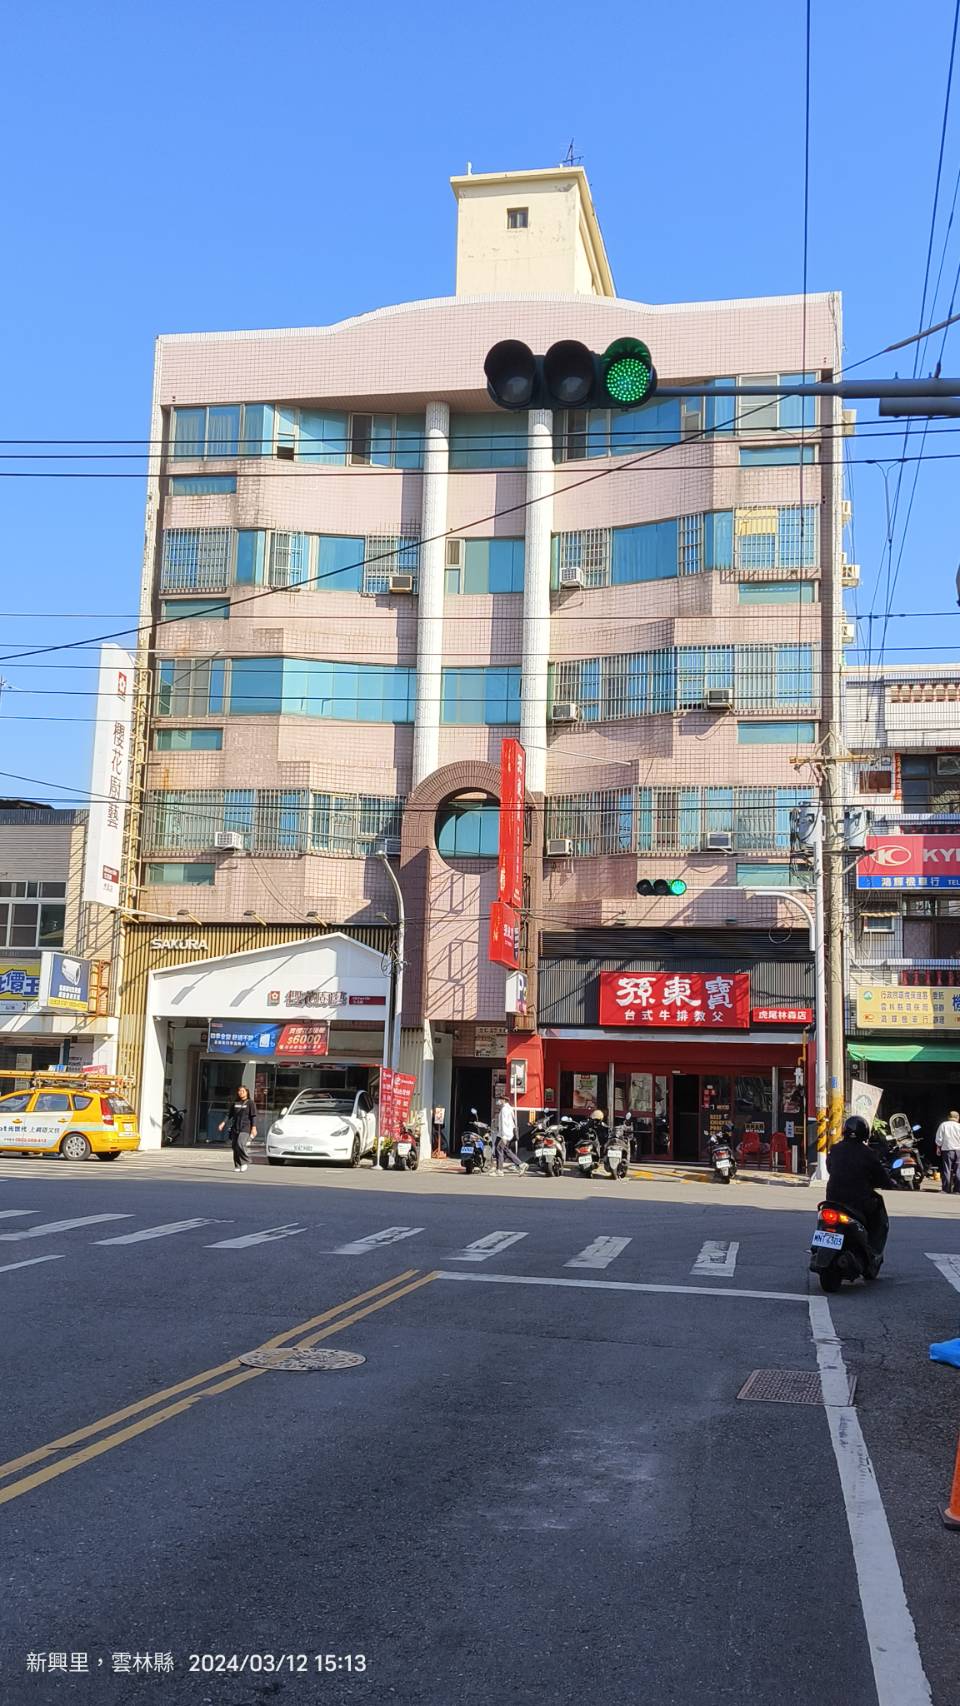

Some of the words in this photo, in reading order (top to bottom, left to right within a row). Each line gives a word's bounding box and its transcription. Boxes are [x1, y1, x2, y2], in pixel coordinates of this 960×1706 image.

[106, 721, 125, 829] 櫻花廚藝
[150, 938, 208, 950] SAKURA
[615, 975, 734, 1010] 孫東寶
[624, 1008, 724, 1022] 台式牛排教父
[758, 1011, 807, 1020] 虎尾林森店
